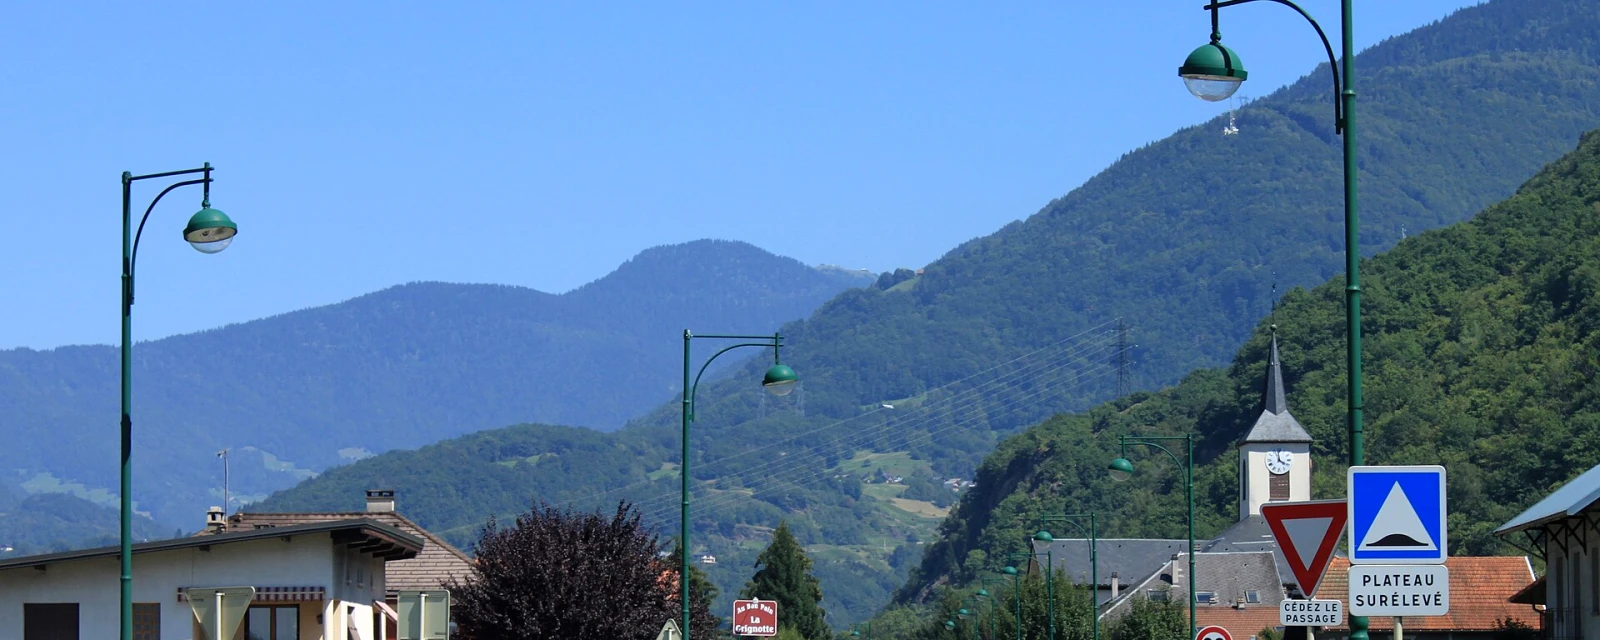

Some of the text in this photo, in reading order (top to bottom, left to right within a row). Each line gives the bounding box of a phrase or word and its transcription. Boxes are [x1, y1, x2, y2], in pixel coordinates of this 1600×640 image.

[1362, 574, 1434, 587] PLATEAU
[1355, 591, 1442, 607] SURÉLEVÉ
[737, 606, 746, 615] Au
[760, 603, 774, 615] Pain
[1284, 601, 1338, 612] CÉDEZ LE
[750, 615, 761, 624] La
[1285, 614, 1336, 623] PASSAGE
[735, 624, 775, 634] Grignotte
